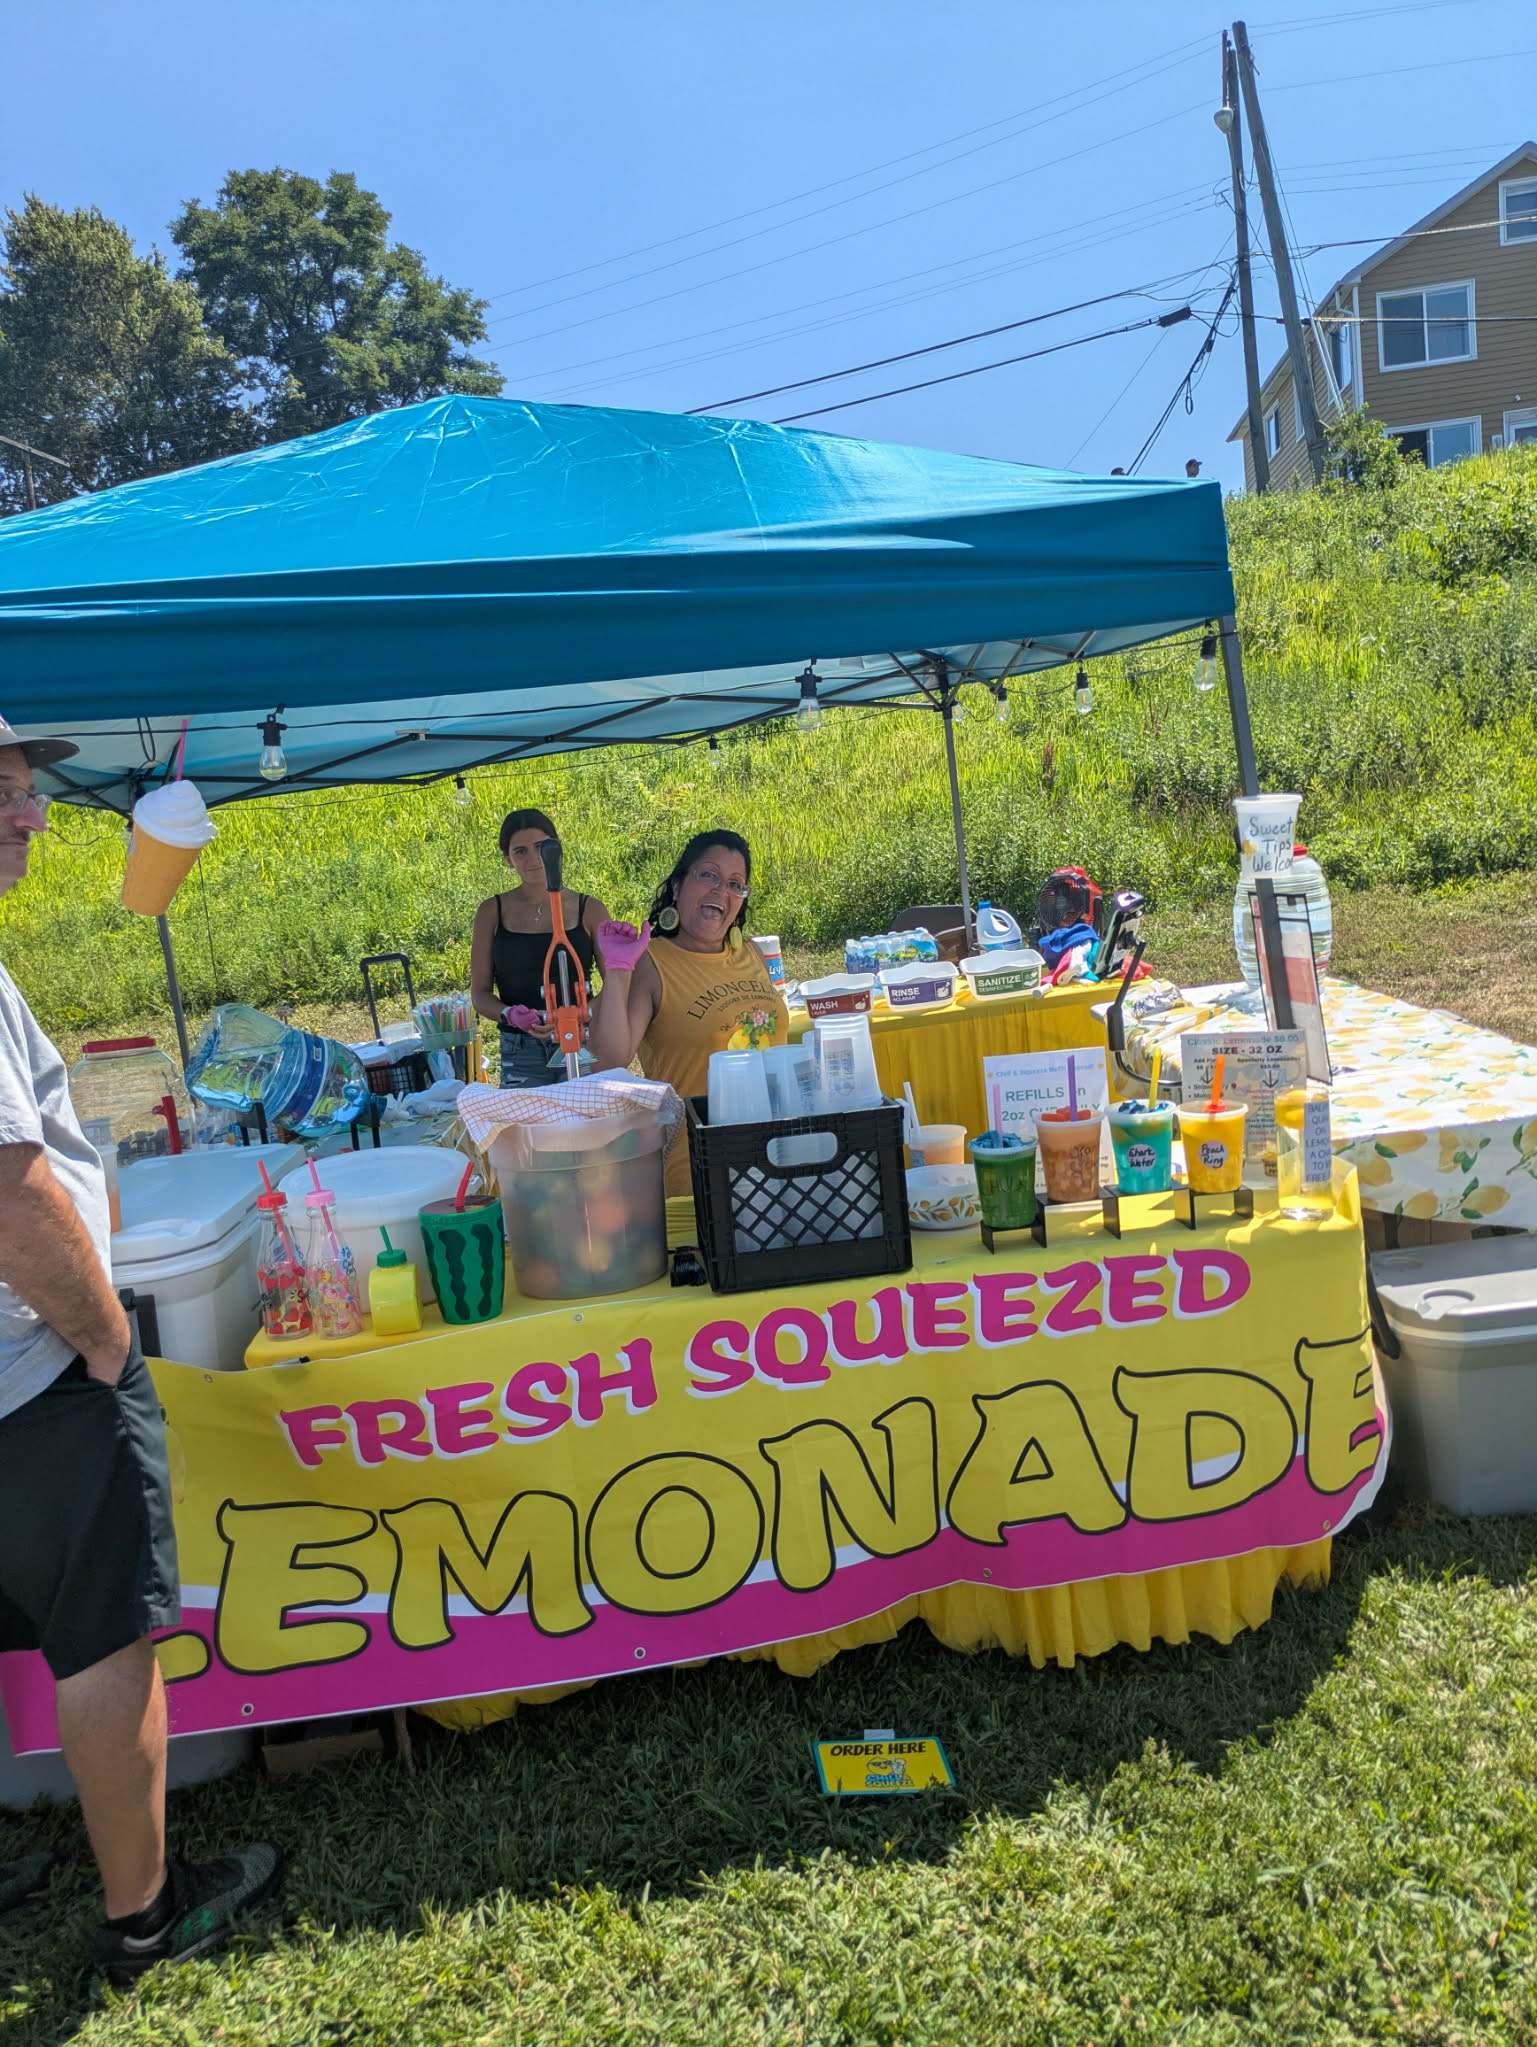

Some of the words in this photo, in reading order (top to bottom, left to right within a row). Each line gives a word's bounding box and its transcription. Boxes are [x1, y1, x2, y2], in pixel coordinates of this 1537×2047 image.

[1250, 816, 1294, 837] Sweet
[1261, 839, 1292, 857] Tips
[1252, 856, 1294, 873] Welco
[977, 974, 1022, 987] SANITIZE
[891, 987, 920, 997] RINSE
[809, 1000, 839, 1011] WASH
[1212, 1046, 1239, 1055] SIZE
[1249, 1046, 1263, 1054] 32
[1266, 1045, 1283, 1054] OZ
[1005, 1087, 1065, 1102] REFILLS
[1201, 1143, 1225, 1154] Peach
[1203, 1155, 1224, 1169] Ring
[281, 1337, 658, 1468] FRESH
[685, 1248, 1251, 1397] SQUEEZED
[151, 1325, 1381, 1683] EMONADE
[830, 1744, 884, 1757] ORDER
[888, 1742, 927, 1755] HERE
